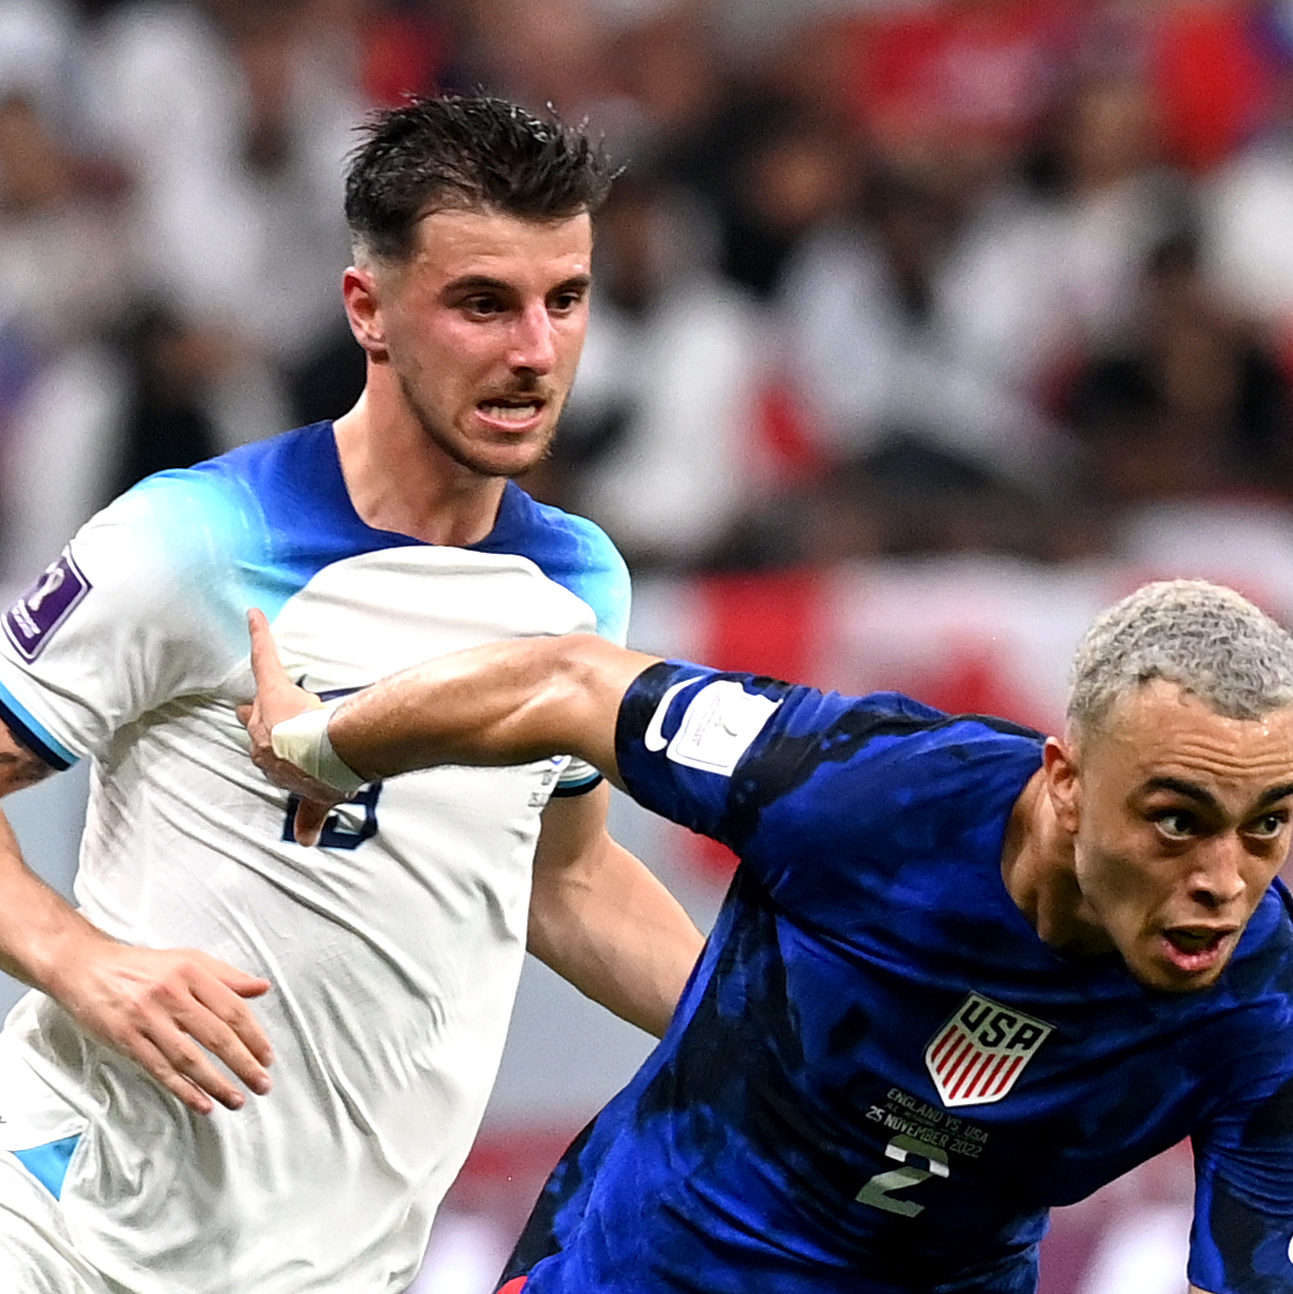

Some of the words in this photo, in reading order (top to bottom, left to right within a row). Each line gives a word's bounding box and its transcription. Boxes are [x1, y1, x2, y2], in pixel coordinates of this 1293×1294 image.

[960, 1000, 1044, 1051] USA
[865, 1105, 885, 1122] 25
[884, 1113, 949, 1148] NOVEMBER
[949, 1138, 982, 1158] 2022
[887, 1087, 944, 1122] ENGLAND
[964, 1125, 989, 1144] USA
[856, 1133, 950, 1218] 2
